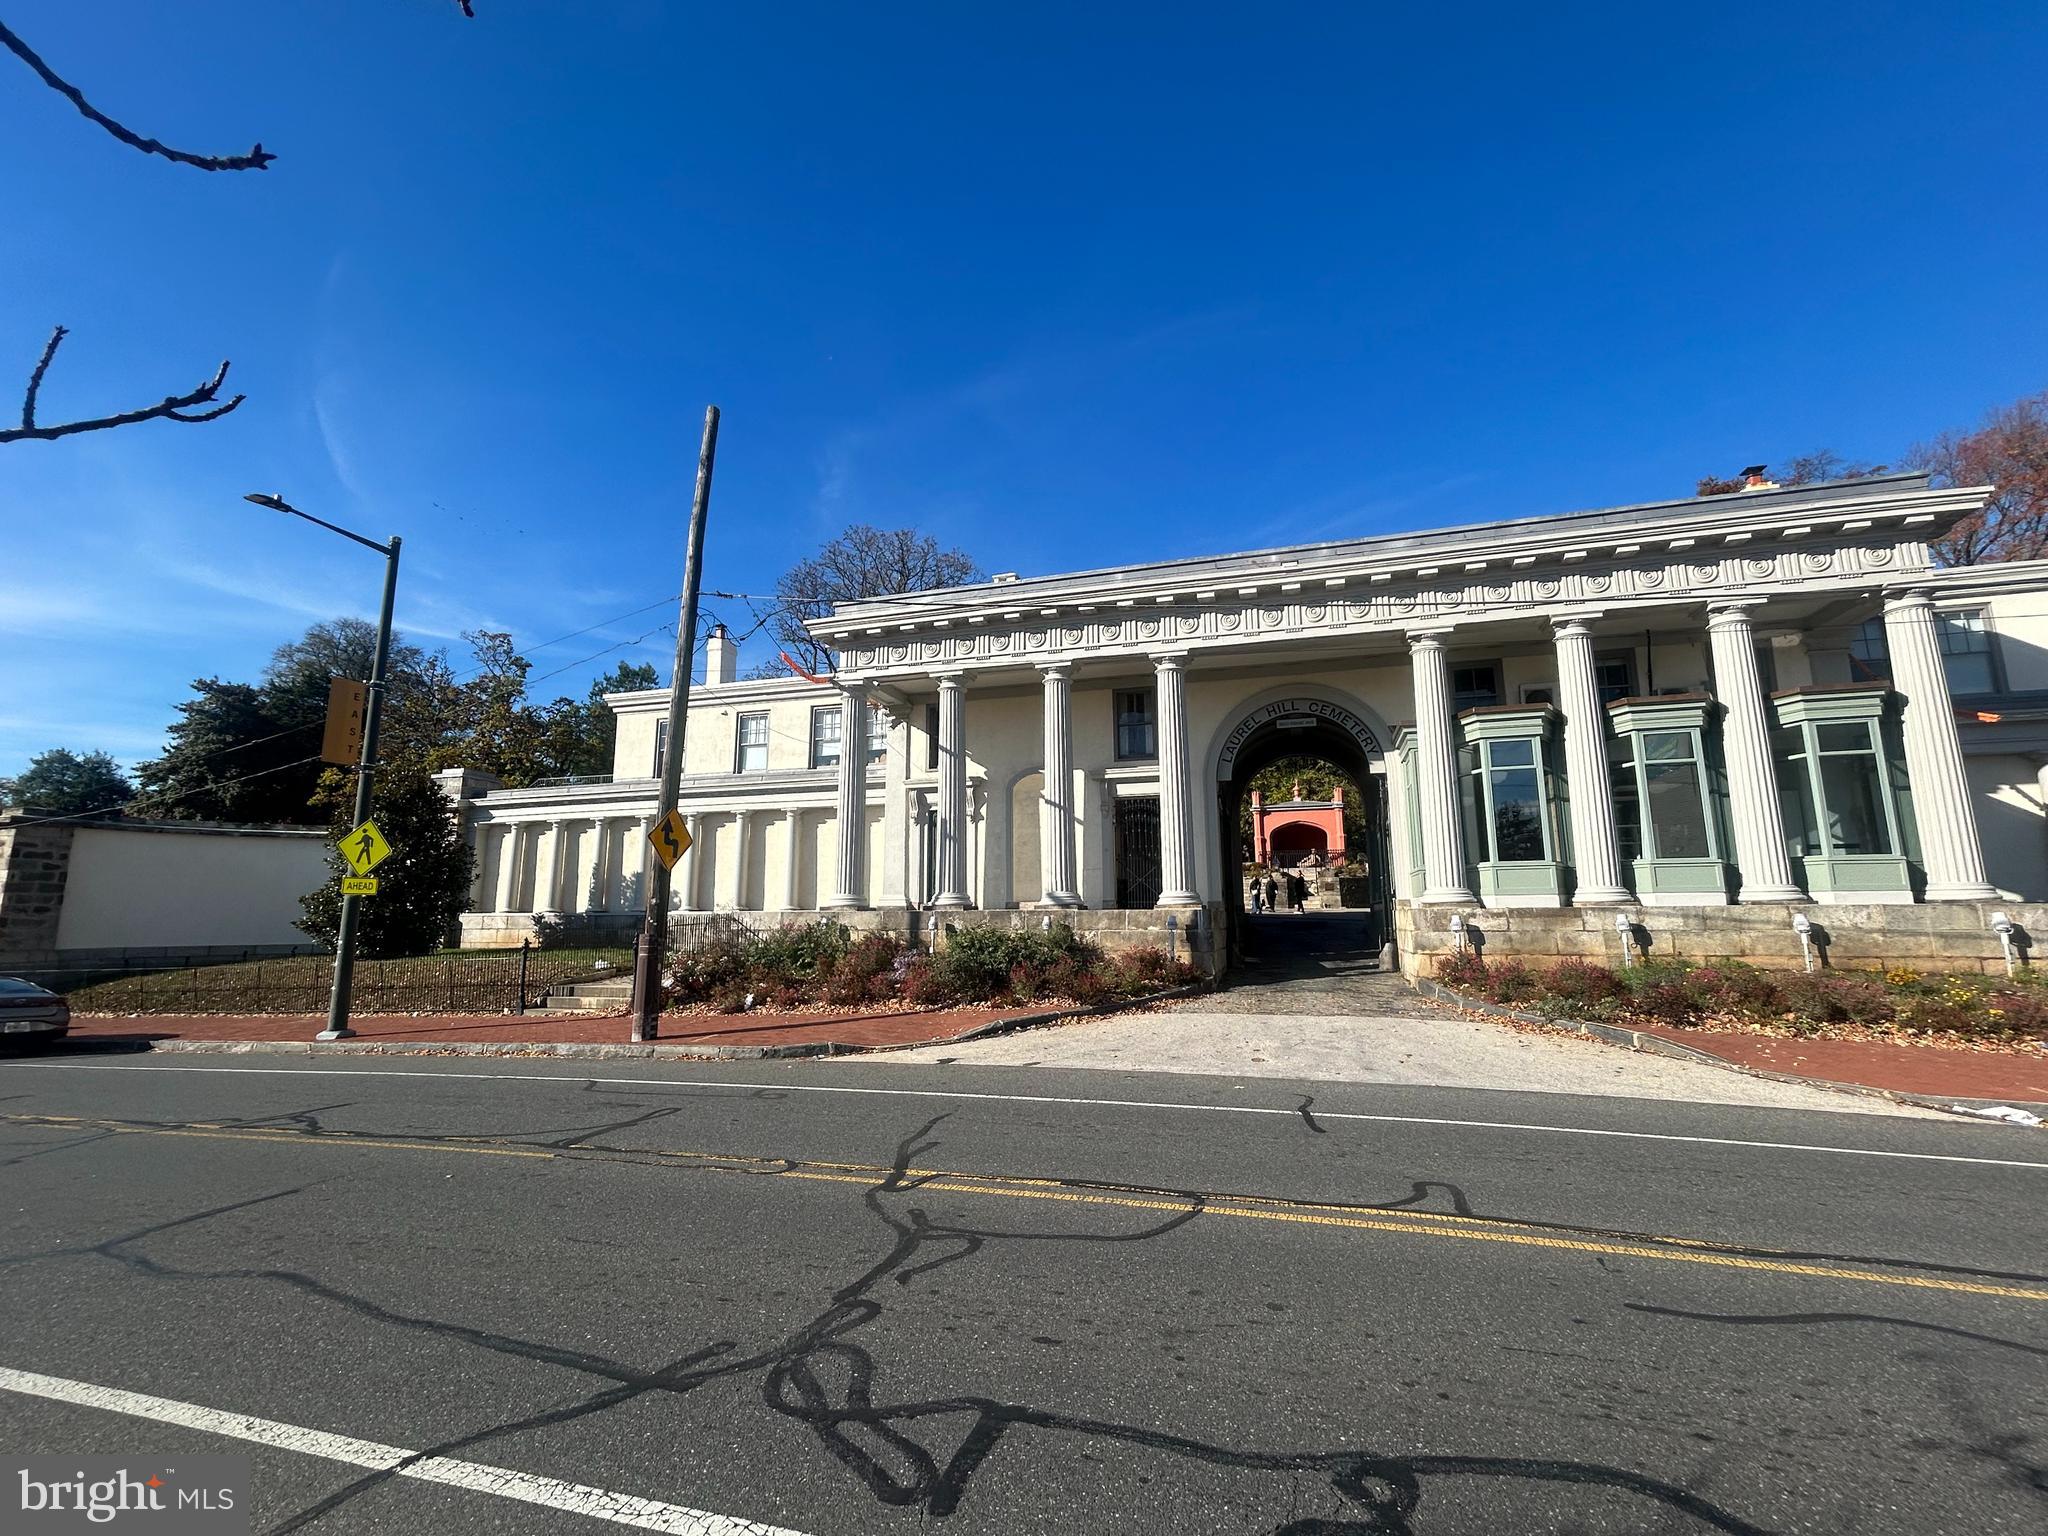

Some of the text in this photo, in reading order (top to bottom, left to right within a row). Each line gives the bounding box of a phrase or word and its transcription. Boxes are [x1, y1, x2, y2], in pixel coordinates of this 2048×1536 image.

[347, 692, 361, 754] EAST
[1223, 701, 1379, 763] LAUREL HILL CEMETERY
[346, 880, 374, 891] AHEAD
